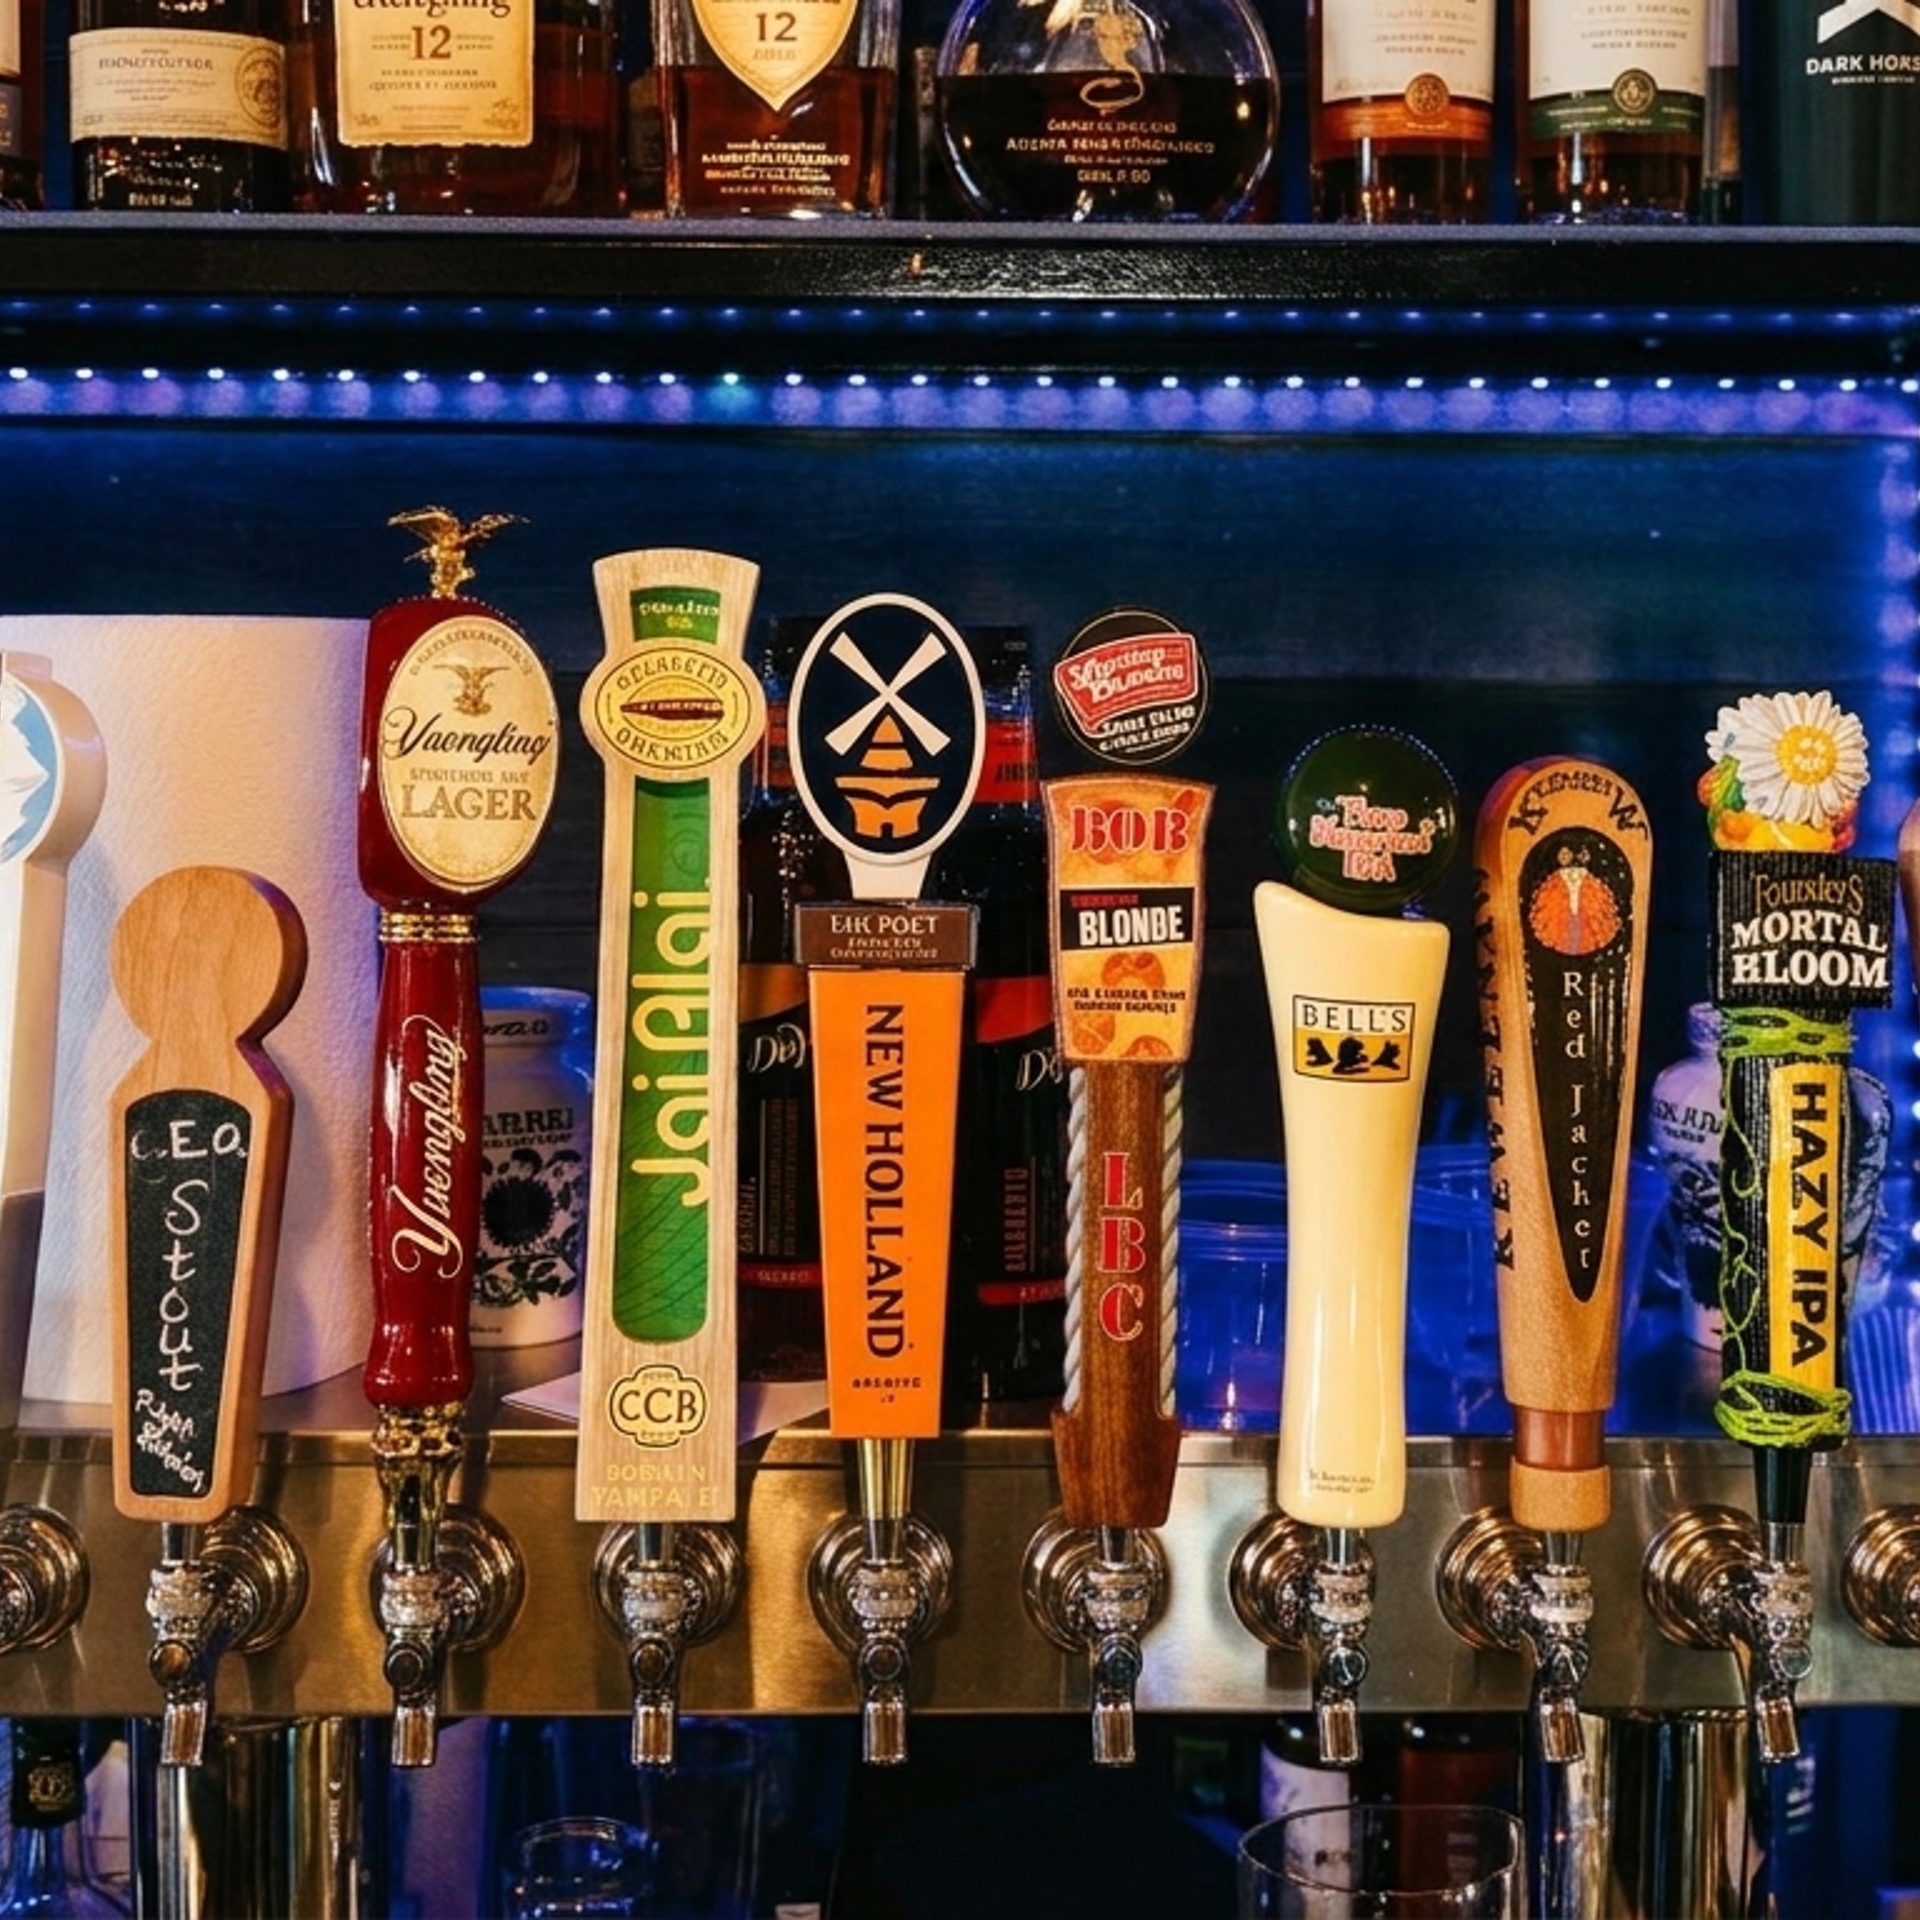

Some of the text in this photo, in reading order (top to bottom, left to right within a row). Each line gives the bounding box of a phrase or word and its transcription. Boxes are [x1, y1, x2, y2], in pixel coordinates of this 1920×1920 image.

[412, 25, 452, 59] 12
[755, 12, 798, 41] 12
[1806, 55, 1863, 75] DARK
[401, 784, 536, 821] LAGER
[1072, 806, 1190, 854] BOB
[879, 914, 938, 935] POET
[1079, 905, 1185, 947] BLONDE
[1730, 909, 1889, 954] MORTAL
[1731, 950, 1890, 988] BLOOM
[1303, 1003, 1406, 1033] BELL'S
[1562, 971, 1586, 1059] Red
[865, 1004, 904, 1110] NEW
[864, 1123, 904, 1358] HOLLAND
[1791, 1083, 1829, 1368] HAZY IPA
[618, 1387, 697, 1424] CCB
